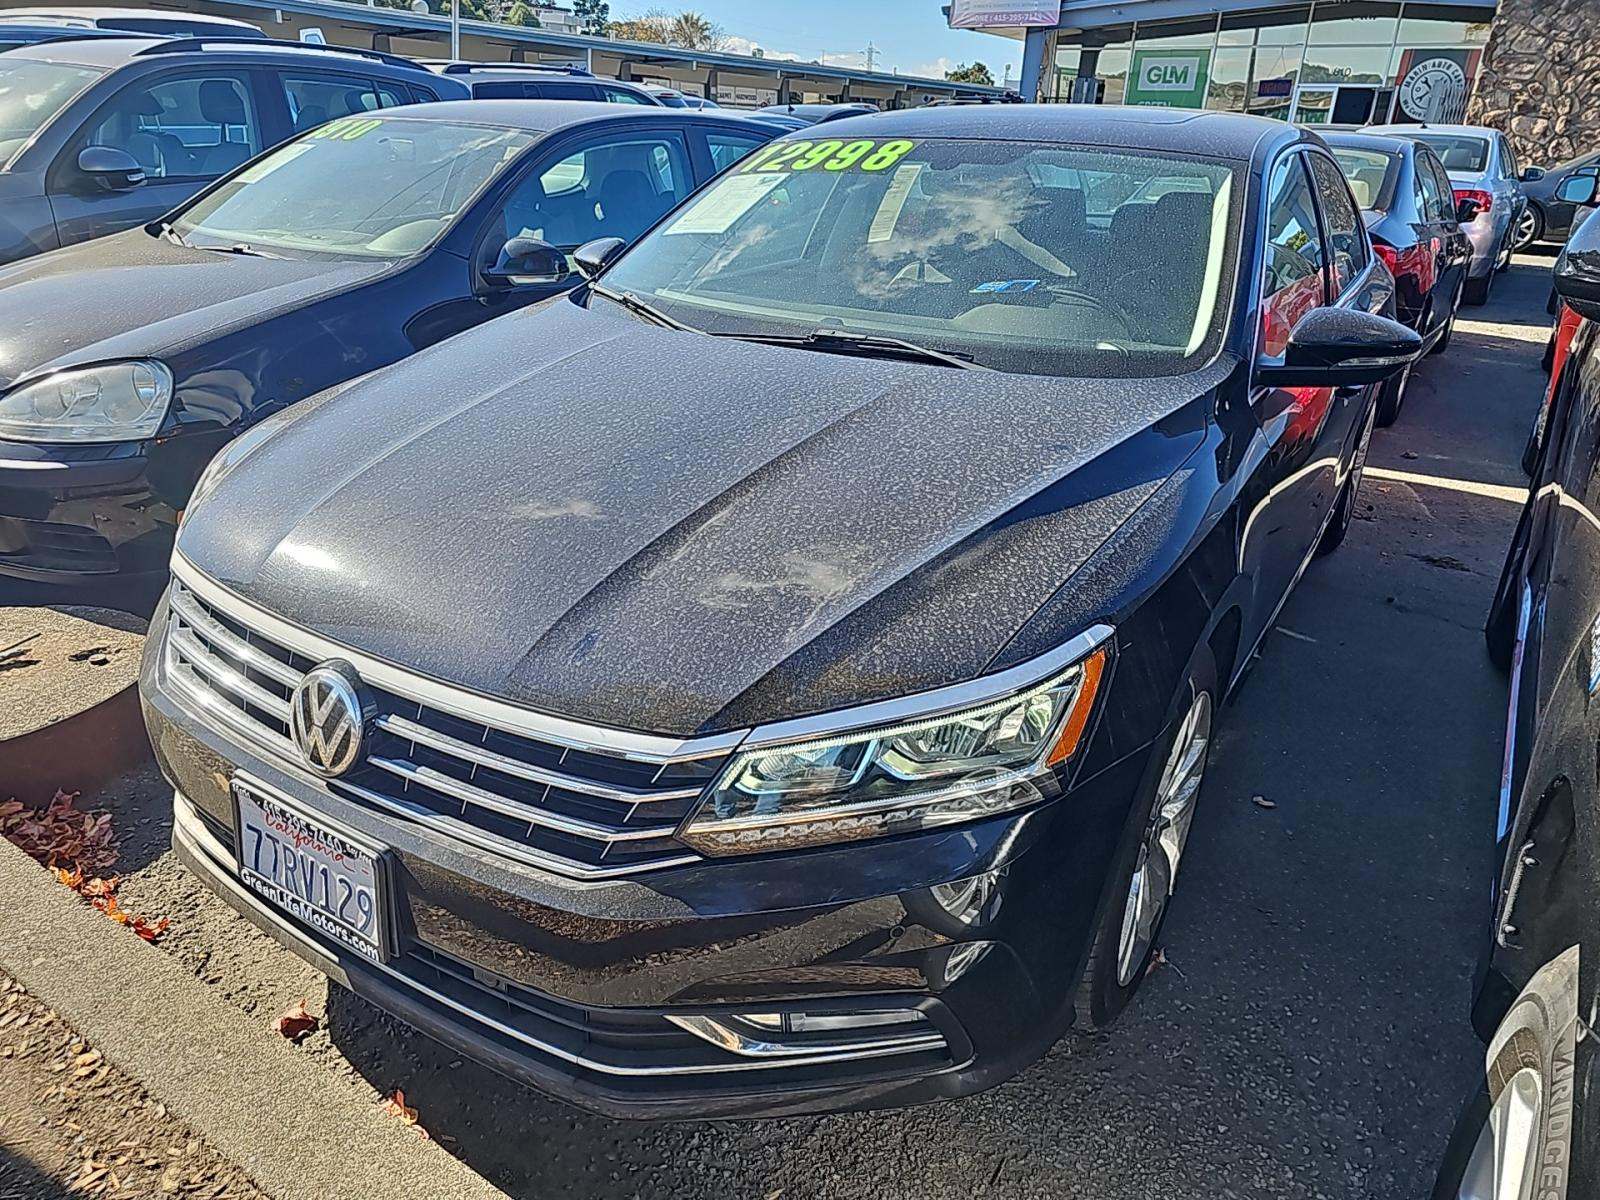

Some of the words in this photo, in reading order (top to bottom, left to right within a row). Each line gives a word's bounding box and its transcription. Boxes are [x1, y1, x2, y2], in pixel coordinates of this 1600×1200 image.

[1146, 64, 1190, 85] GLM
[1403, 64, 1428, 88] MARIN
[1431, 60, 1453, 68] AUTO
[741, 139, 915, 171] 12998
[264, 812, 356, 873] California
[246, 822, 373, 932] 7TRV129
[240, 867, 380, 962] GreenLifeMotors.com
